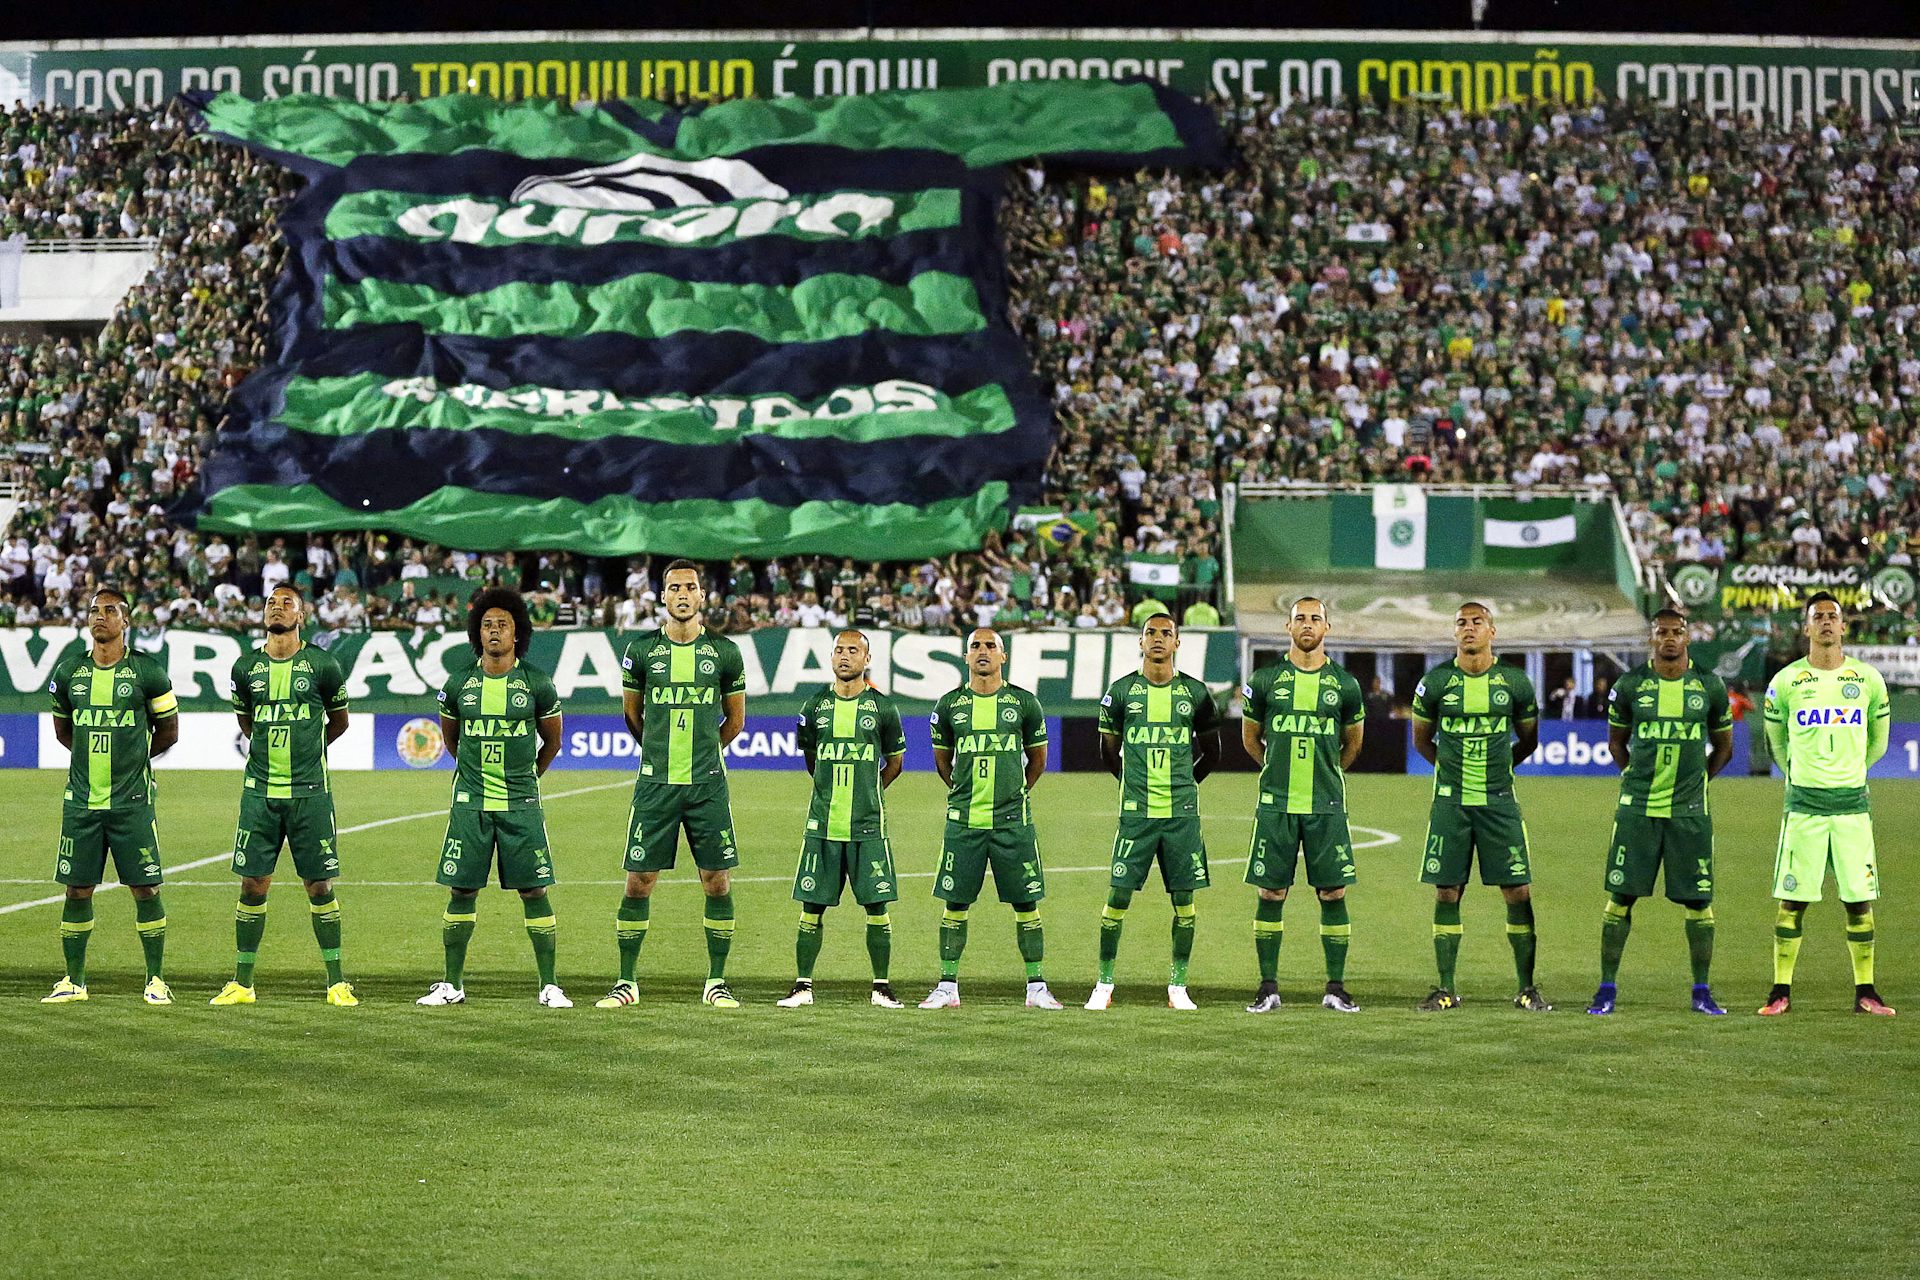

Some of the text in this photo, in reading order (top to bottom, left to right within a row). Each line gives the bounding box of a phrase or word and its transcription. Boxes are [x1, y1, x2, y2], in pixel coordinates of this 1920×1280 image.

[651, 686, 715, 705] CAIXA
[72, 708, 136, 727] CAIXA
[676, 711, 686, 732] 4
[1271, 714, 1335, 735] CAIXA
[1441, 715, 1508, 734] CAIXA
[1796, 708, 1862, 726] CAIXA
[271, 728, 289, 748] 27
[464, 719, 528, 737] CAIXA
[1126, 726, 1190, 745] CAIXA
[1637, 721, 1702, 740] CAIXA
[92, 734, 109, 754] 20
[957, 733, 1017, 754] CAIXA
[1297, 739, 1306, 760] 5
[484, 744, 502, 764] 25
[1152, 749, 1165, 769] 17
[1663, 746, 1673, 766] 6
[837, 766, 848, 787] 11
[979, 759, 988, 778] 8
[236, 828, 251, 850] 27
[633, 822, 643, 843] 4
[60, 835, 74, 857] 20
[444, 838, 462, 860] 25
[1117, 838, 1135, 859] 17
[1256, 839, 1267, 859] 5
[1428, 834, 1444, 857] 21
[1615, 845, 1626, 866] 6
[945, 851, 955, 872] 8
